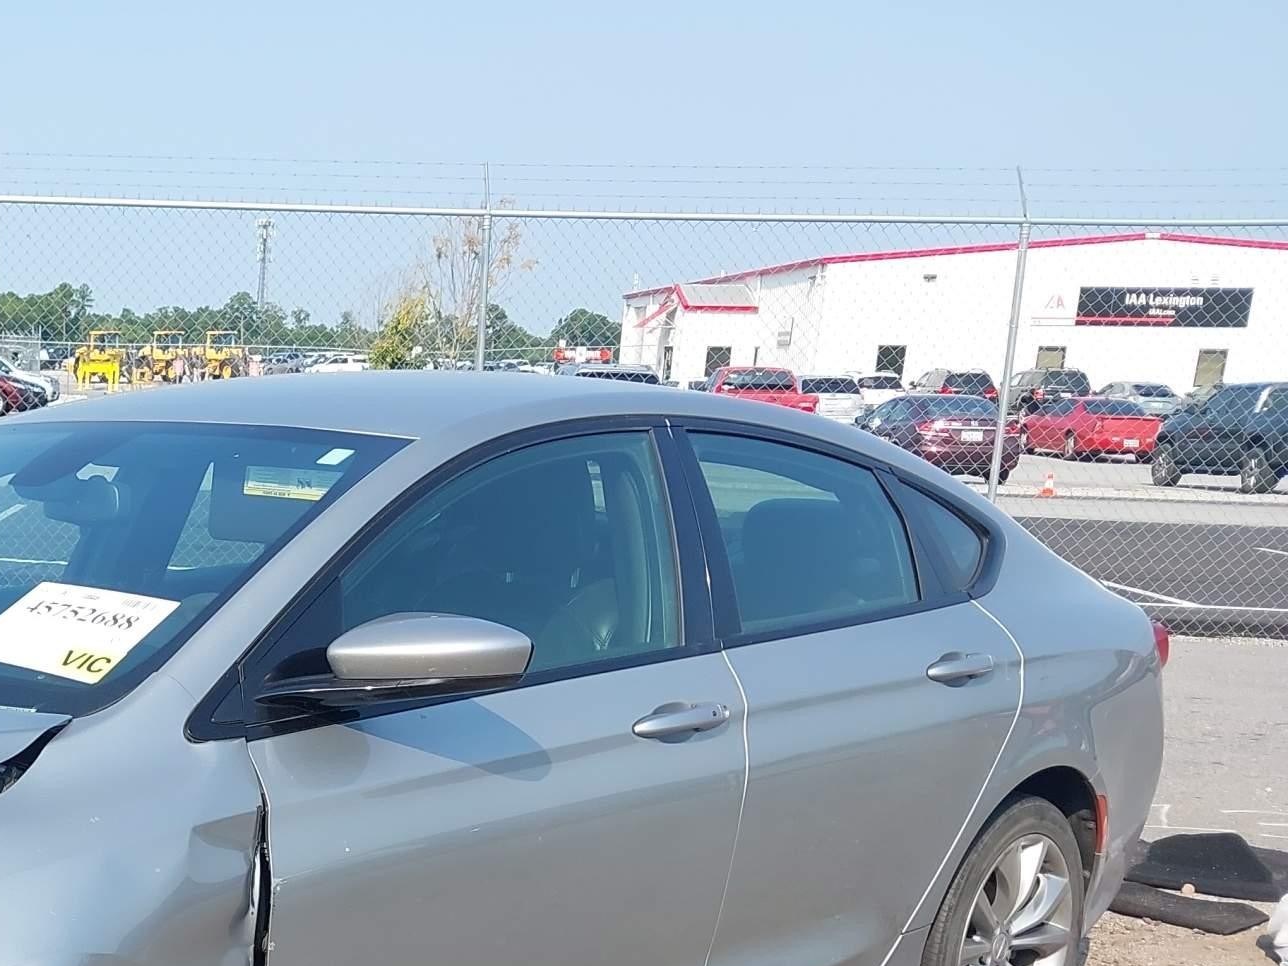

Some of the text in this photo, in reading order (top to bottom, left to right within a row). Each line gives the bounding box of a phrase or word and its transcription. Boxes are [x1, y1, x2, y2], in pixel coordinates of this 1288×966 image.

[1125, 293, 1204, 308] IAA Lexington
[26, 600, 141, 631] 45752688
[60, 649, 112, 673] VIC
